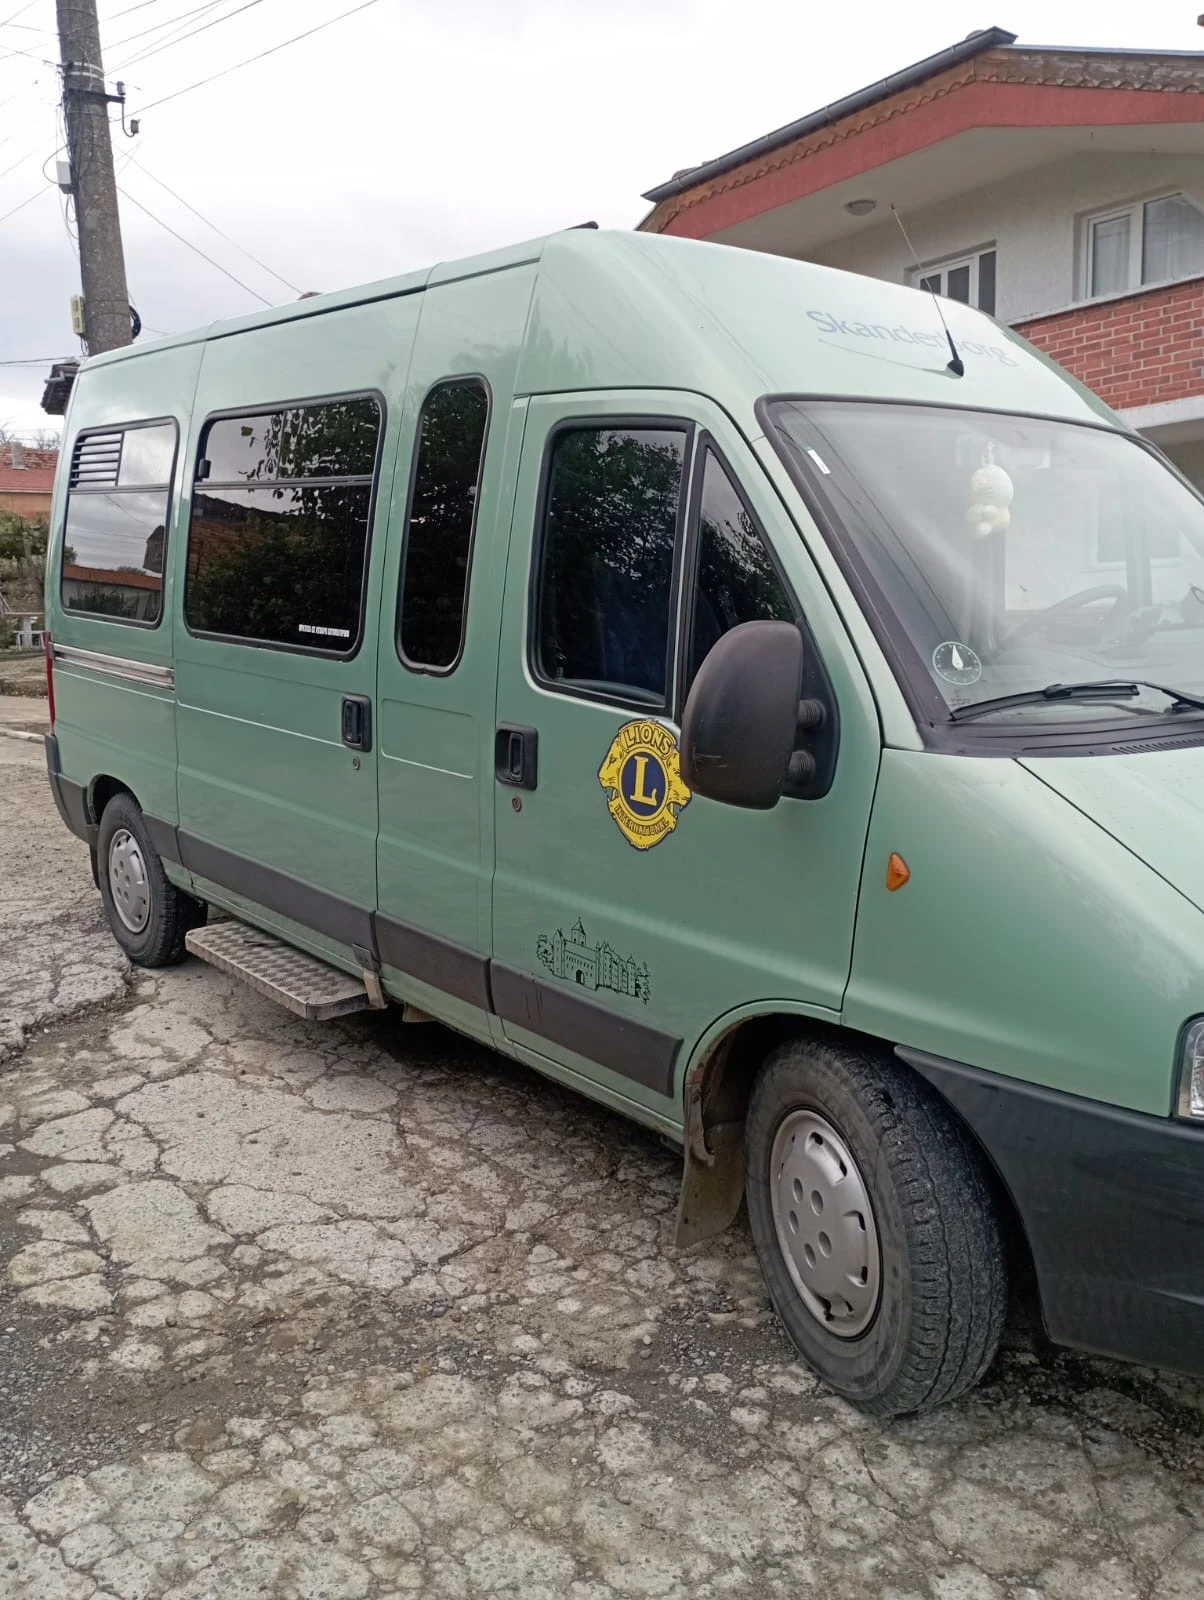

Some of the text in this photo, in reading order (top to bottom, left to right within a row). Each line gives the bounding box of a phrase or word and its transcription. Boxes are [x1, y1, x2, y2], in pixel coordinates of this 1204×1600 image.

[622, 724, 672, 757] LIONS
[630, 755, 657, 806] L
[613, 804, 670, 836] INTERNATIONAL
